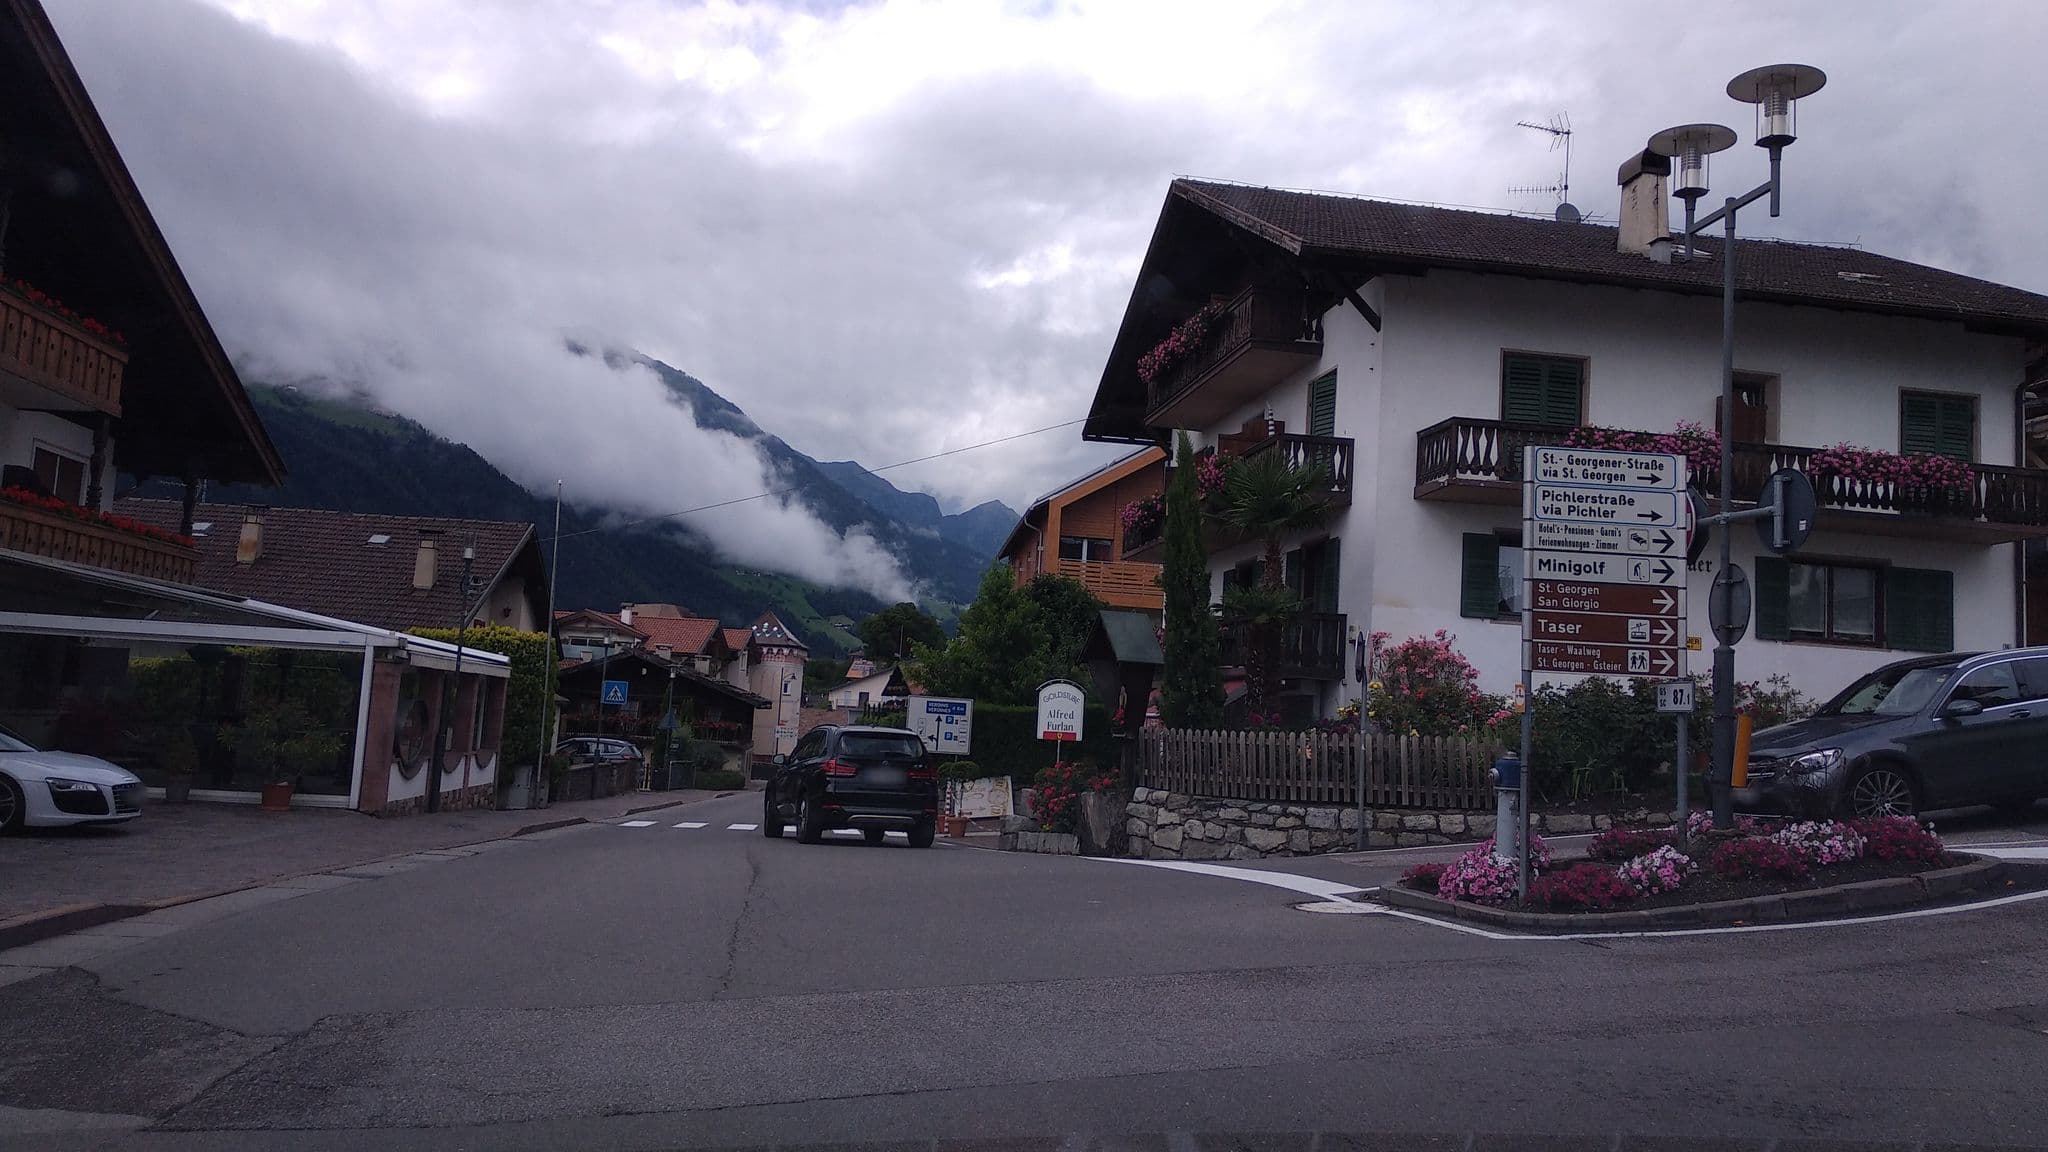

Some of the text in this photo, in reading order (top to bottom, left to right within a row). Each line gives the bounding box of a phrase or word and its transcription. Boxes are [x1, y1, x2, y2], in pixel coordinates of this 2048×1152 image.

[1567, 454, 1664, 471] Georgener-Straße
[1542, 466, 1626, 483] via St. Georgen
[1542, 490, 1635, 506] Pichlerstraße
[1542, 503, 1616, 519] via Pichler
[1564, 524, 1595, 536] Pensionen
[1600, 526, 1622, 538] Garni's
[1538, 536, 1590, 550] Ferienwohnungen
[1595, 539, 1619, 550] Zimmer
[1538, 558, 1606, 576] Minigolf
[1538, 582, 1600, 597] St. Georgen
[1538, 596, 1600, 610] San Giorgio
[1537, 618, 1583, 634] Taser
[1537, 643, 1558, 654] Taser
[1567, 645, 1601, 659] Waalweg
[1537, 657, 1550, 668] St.
[1552, 658, 1585, 671] Georgen
[1593, 659, 1622, 672] Gsteier
[1673, 689, 1690, 705] 87.1
[1047, 709, 1074, 720] Alfred
[1047, 721, 1074, 732] Furlan
